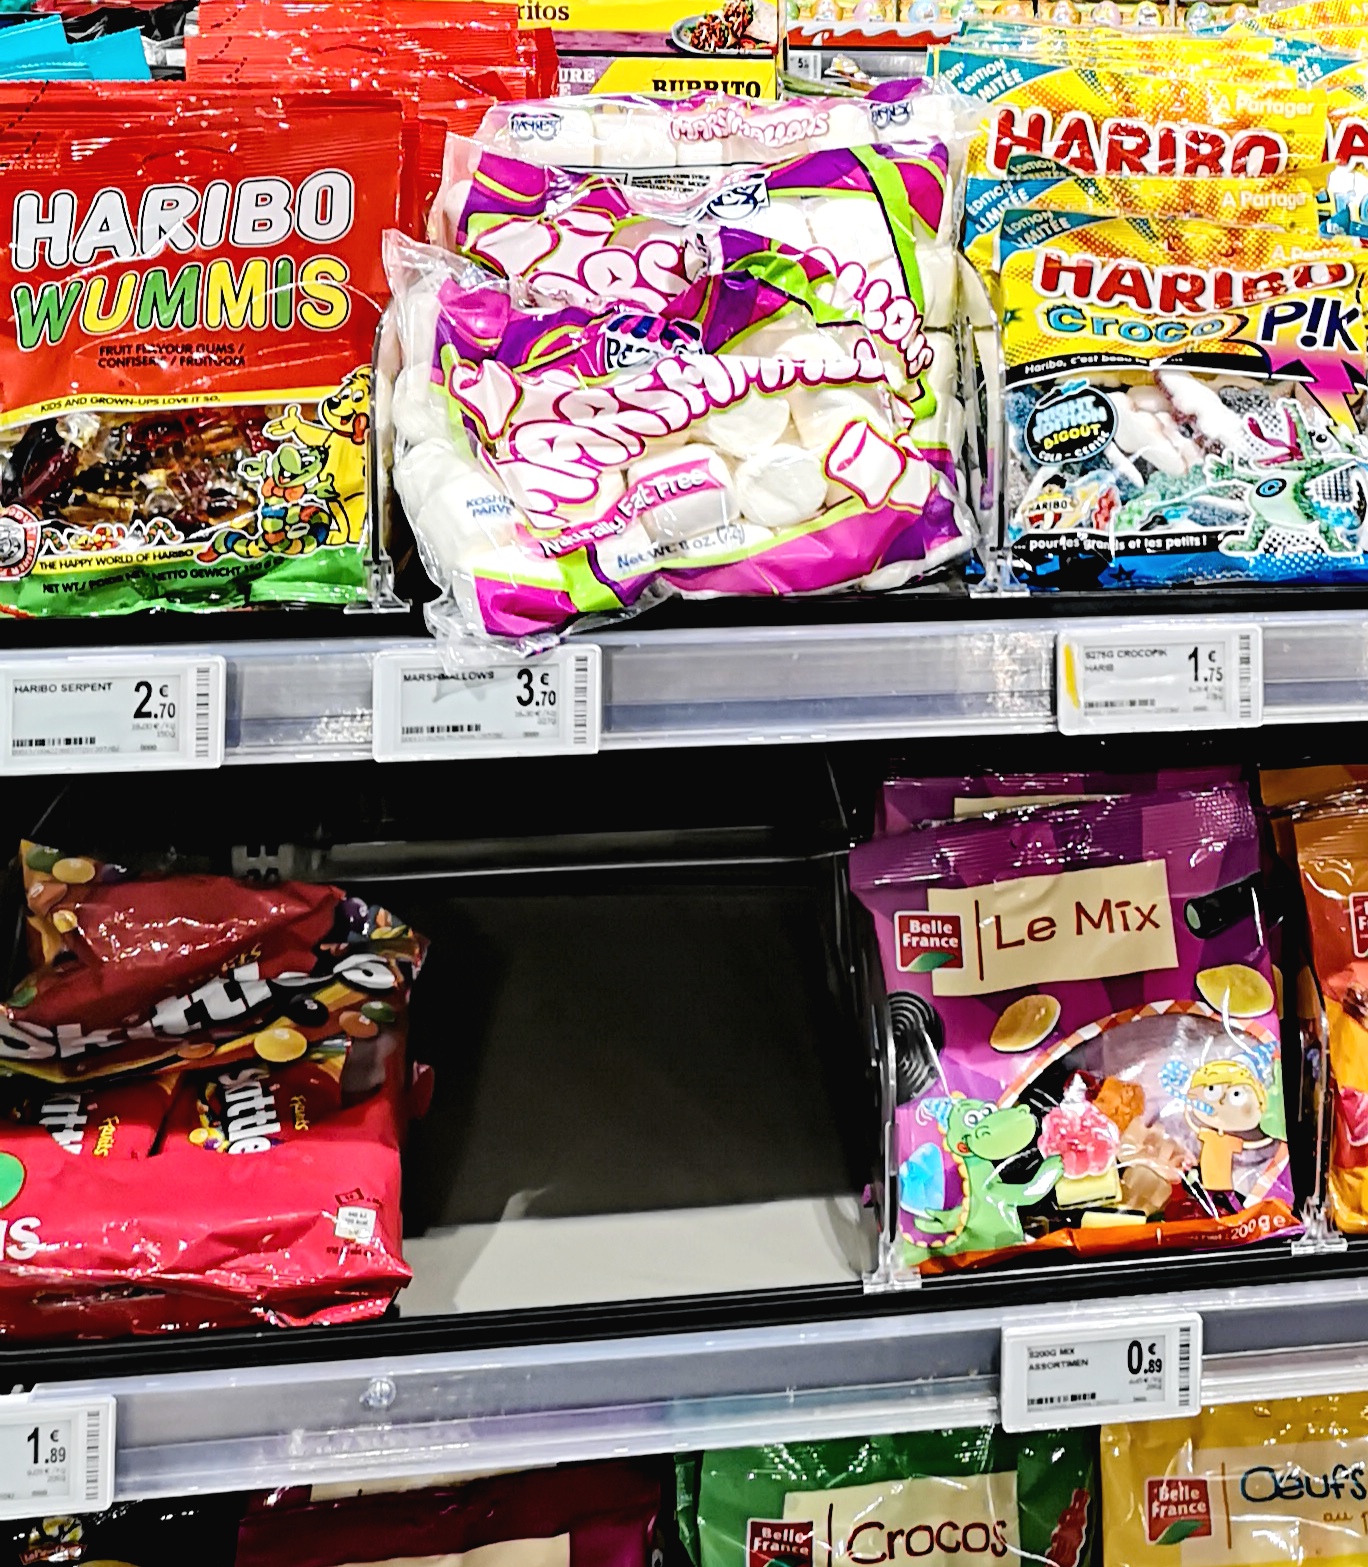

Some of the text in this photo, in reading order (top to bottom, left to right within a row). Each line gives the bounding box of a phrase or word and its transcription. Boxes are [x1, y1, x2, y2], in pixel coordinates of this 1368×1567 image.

[1235, 88, 1315, 117] Partager
[991, 107, 1287, 177] HARIBO
[10, 167, 355, 274] HARIBO
[1034, 251, 1350, 316] HARIBO
[12, 254, 351, 353] WUMMIS
[1042, 303, 1231, 346] Croco
[99, 343, 134, 356] FRUIT
[40, 395, 200, 413] KIDS AND GROWN-UPS LOVE IT
[618, 484, 653, 519] Fat
[653, 468, 706, 500] Free
[38, 549, 195, 571] THE HAPPY WORLD OF HARIBO
[14, 681, 113, 694] HARIBO SERPENT
[908, 918, 953, 935] Belle
[993, 911, 1058, 951] Le
[902, 931, 959, 950] France
[1154, 1483, 1201, 1502] Belle
[1150, 1499, 1207, 1518] France
[1322, 1509, 1353, 1525] au
[846, 1520, 1008, 1564] Crocos
